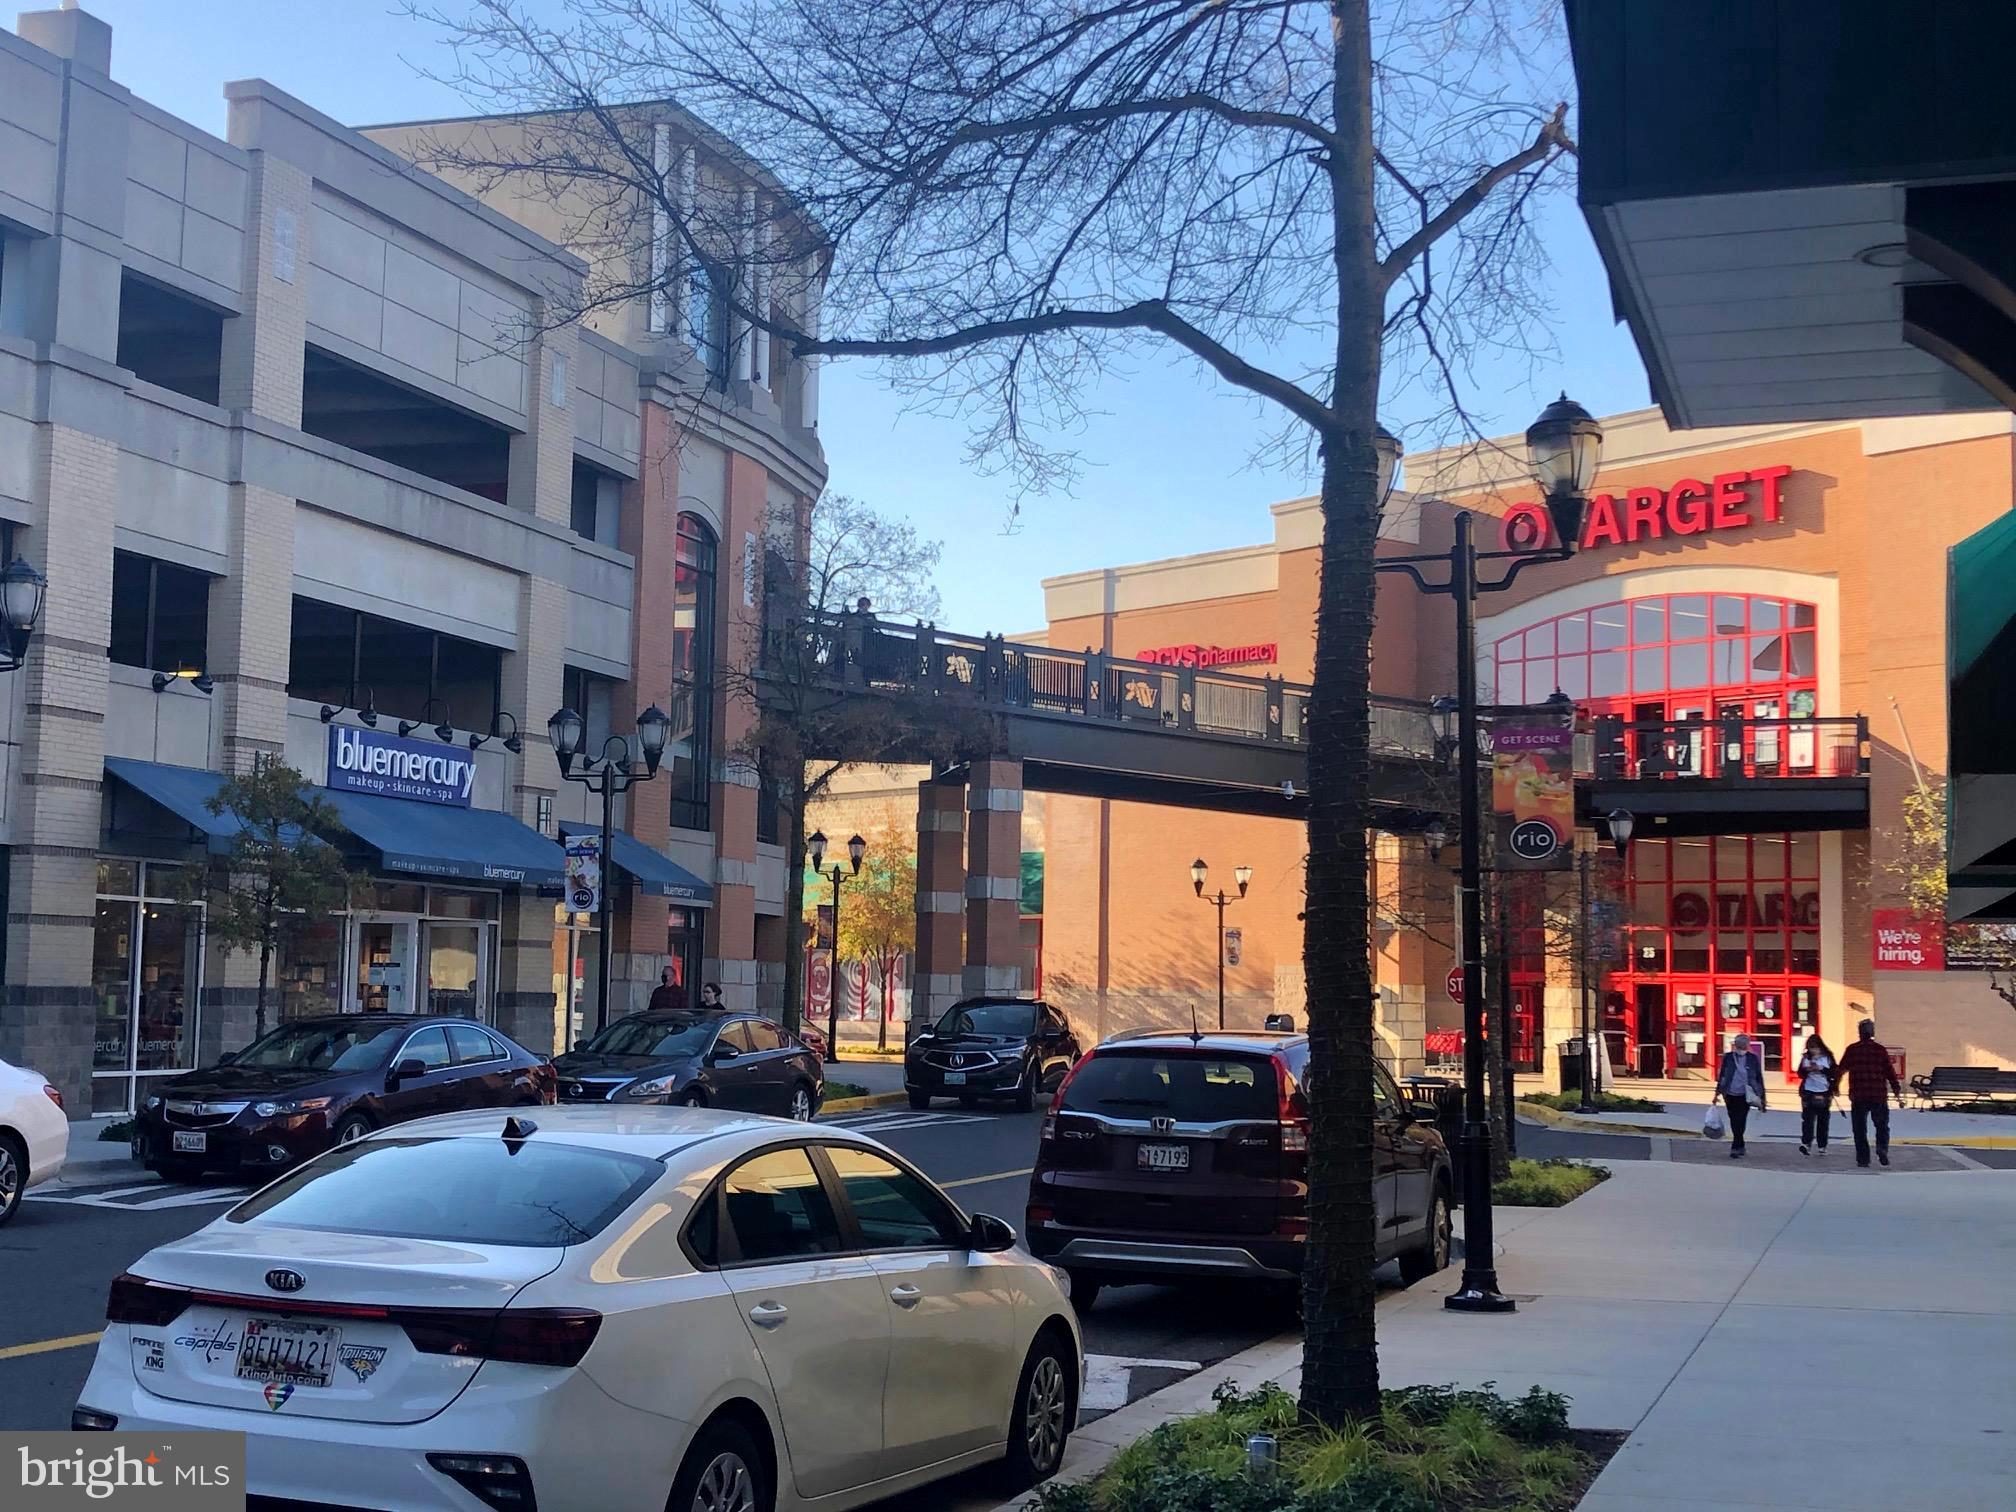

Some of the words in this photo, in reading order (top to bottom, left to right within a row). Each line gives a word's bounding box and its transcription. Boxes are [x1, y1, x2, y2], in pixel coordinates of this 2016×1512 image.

[1580, 464, 1792, 549] ARGET
[1156, 644, 1197, 668] CVS
[1200, 643, 1278, 670] pharmacy
[1501, 735, 1525, 745] GET
[1526, 734, 1561, 744] SCENE
[336, 727, 477, 798] bluemercury
[347, 775, 385, 792] makeup
[392, 781, 431, 797] skincare
[438, 788, 452, 801] spa
[1517, 831, 1550, 846] rio
[483, 863, 526, 882] bluemercury
[574, 892, 589, 902] rio
[663, 882, 696, 900] bluemercury
[1717, 892, 1820, 934] TARG
[1878, 929, 1922, 945] We're
[1878, 947, 1925, 965] hiring.
[1449, 977, 1464, 993] ST
[270, 1272, 297, 1288] KIA
[174, 1320, 238, 1358] capitals
[243, 1335, 329, 1370] 8EH7121
[340, 1345, 385, 1362] TOWSON
[144, 1355, 164, 1370] KING
[240, 1367, 323, 1386] KingAuto.com
